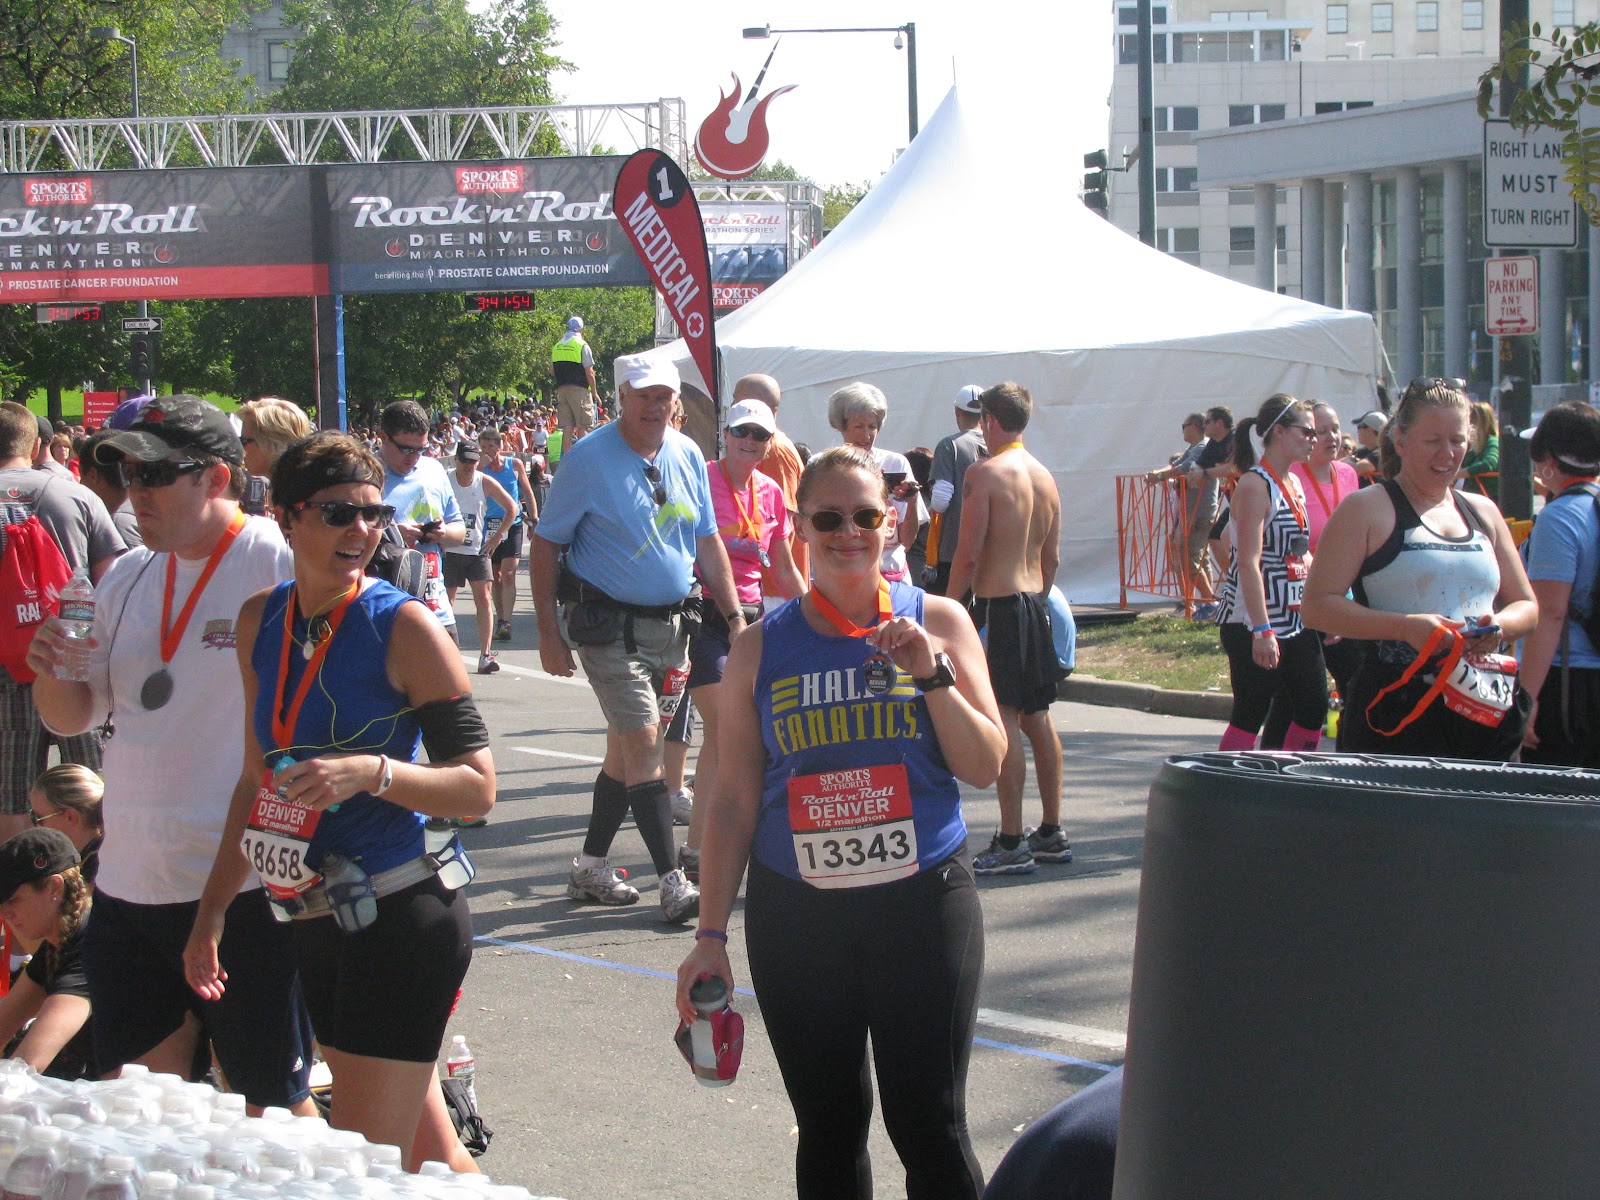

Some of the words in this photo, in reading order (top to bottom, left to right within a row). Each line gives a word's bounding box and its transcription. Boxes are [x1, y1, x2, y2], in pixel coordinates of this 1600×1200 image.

[1490, 142, 1528, 158] RIGHT
[461, 169, 518, 184] SPORTS
[656, 166, 673, 201] 1
[1502, 174, 1558, 193] MUST
[30, 181, 87, 195] SPORTS
[463, 181, 519, 191] AUTHORITY
[31, 193, 88, 202] AUTHORITY
[0, 209, 50, 237] ck
[91, 203, 199, 235] Roll
[350, 196, 486, 228] Rock
[702, 215, 726, 225] ock
[744, 213, 781, 225] Roll
[1491, 209, 1524, 225] TURN
[1531, 210, 1570, 225] RIGHT
[409, 230, 572, 247] DENVER
[9, 241, 141, 258] ENVER
[410, 246, 574, 260] MARATHON
[624, 191, 699, 320] MEDICAL
[11, 258, 142, 271] MARATHON
[439, 268, 493, 279] PROSTATE
[495, 266, 539, 277] CANCER
[541, 264, 609, 276] FOUNDATION
[1503, 263, 1518, 277] NO
[8, 279, 61, 290] PROSTATE
[63, 278, 108, 288] CANCER
[110, 276, 179, 287] FOUNDATION
[1489, 279, 1533, 293] PARKING
[712, 287, 759, 298] PORTS
[1501, 295, 1521, 305] ANY
[1500, 306, 1523, 316] TIME
[801, 668, 875, 707] HAL
[773, 701, 918, 755] FANATICS
[820, 768, 871, 786] SPORTS
[822, 780, 872, 792] AUTHORITY
[259, 788, 285, 804] Roc
[801, 793, 847, 805] Rock
[858, 786, 895, 799] Roll
[257, 801, 307, 825] DENVER
[808, 797, 890, 820] DENVER
[258, 818, 269, 826] 1/2
[269, 821, 300, 833] marathon
[834, 814, 886, 826] marathon
[802, 830, 911, 870] 13343
[244, 838, 303, 881] 18658
